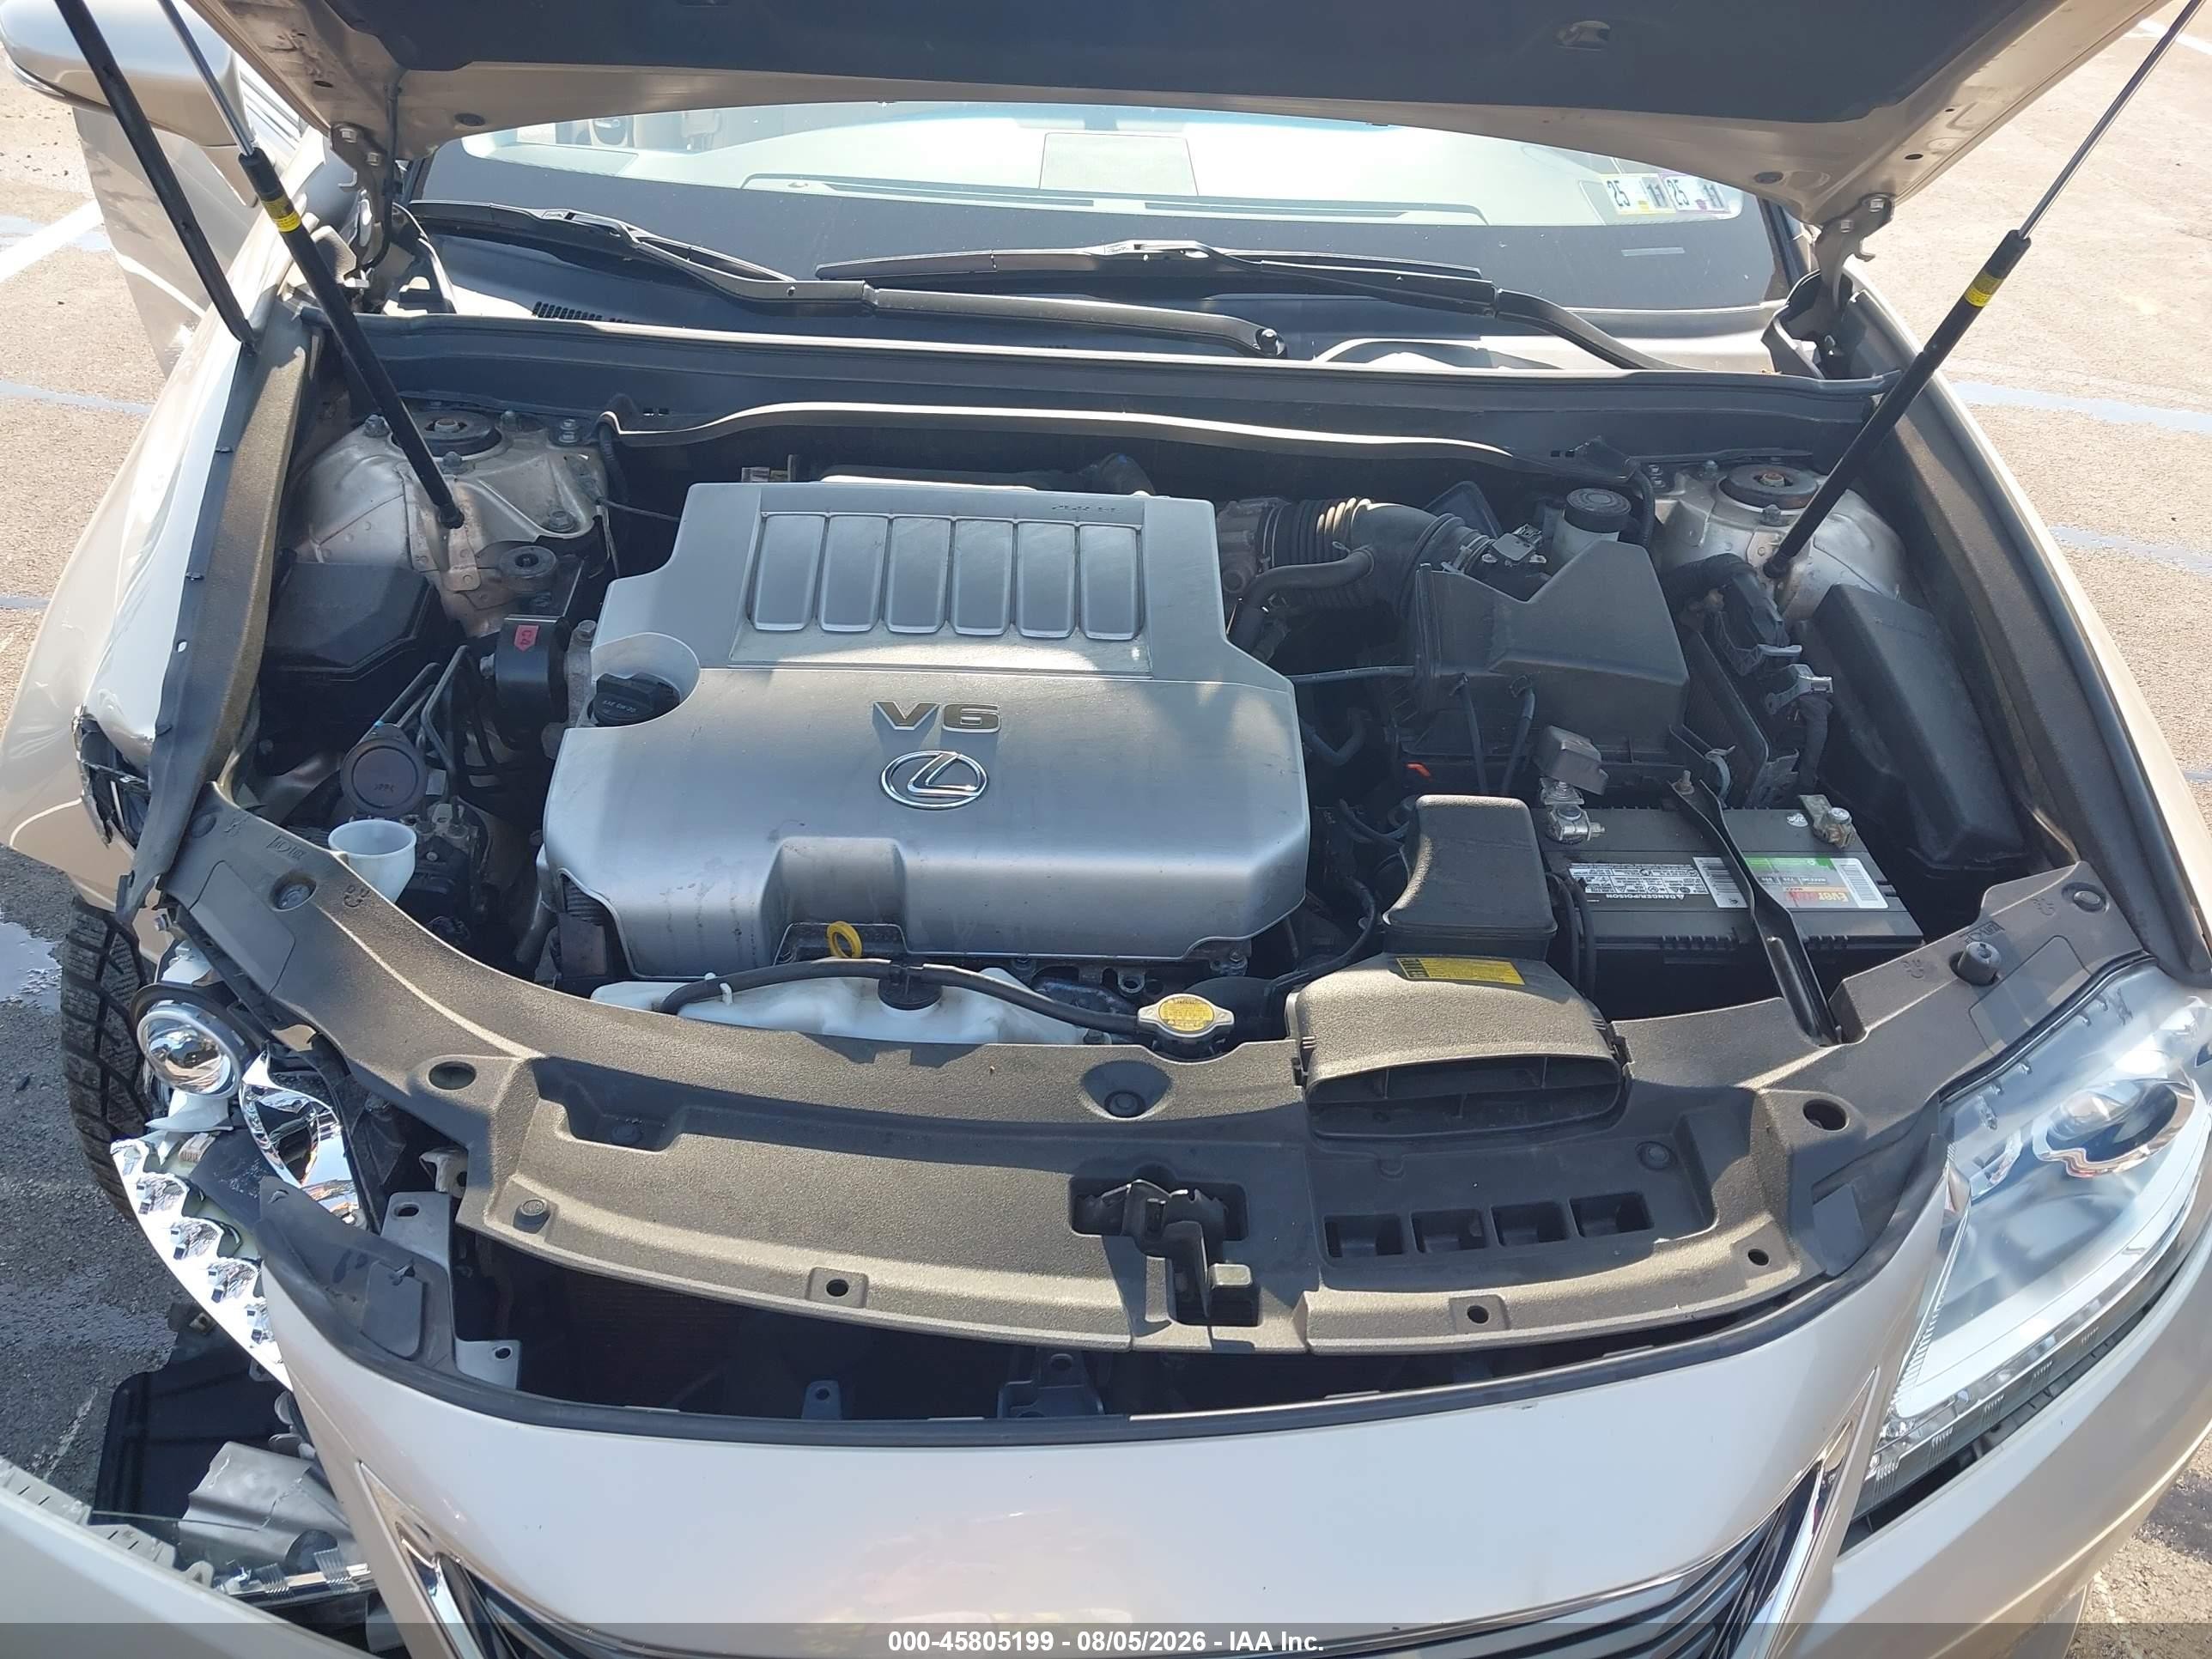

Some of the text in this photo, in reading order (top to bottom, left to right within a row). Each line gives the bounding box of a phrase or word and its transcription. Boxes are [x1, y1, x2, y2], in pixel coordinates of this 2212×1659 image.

[1607, 179, 1668, 207] 25 11
[1667, 179, 1725, 208] 25 11
[872, 701, 1000, 732] V6
